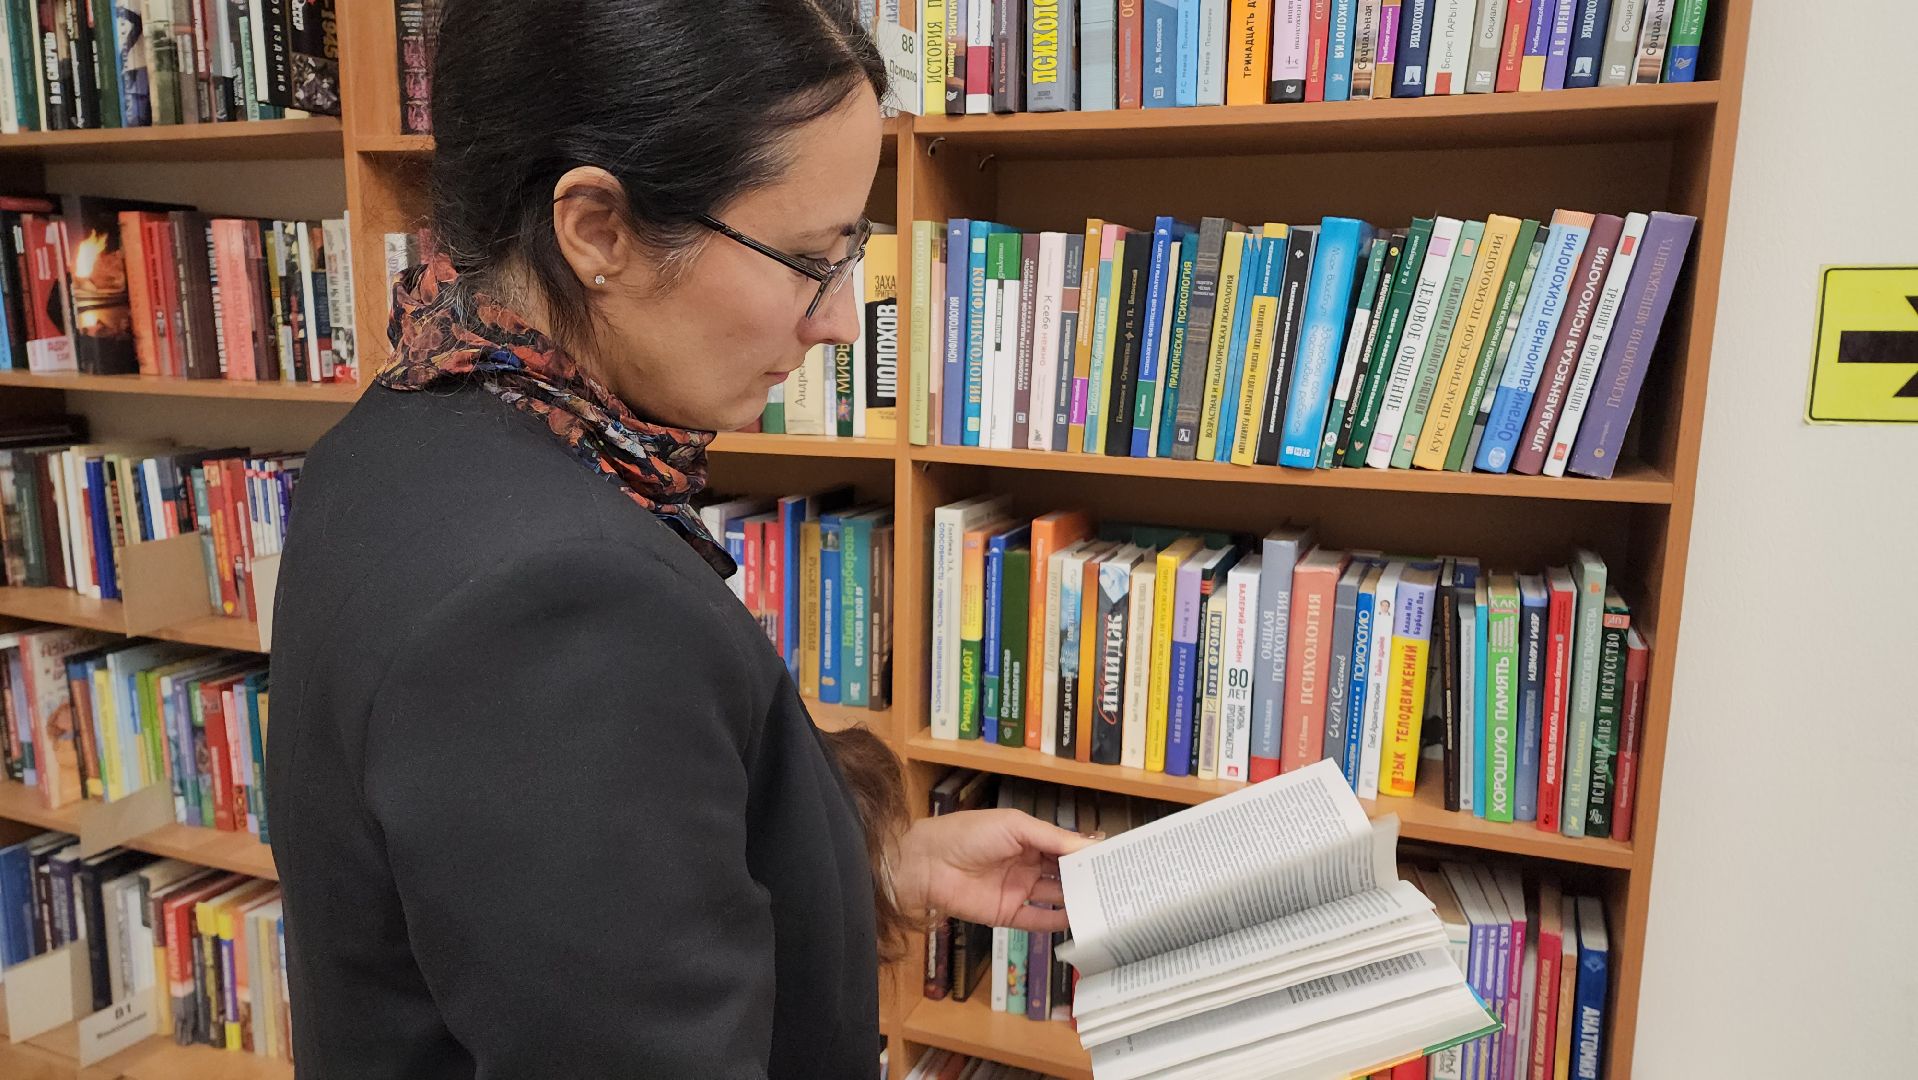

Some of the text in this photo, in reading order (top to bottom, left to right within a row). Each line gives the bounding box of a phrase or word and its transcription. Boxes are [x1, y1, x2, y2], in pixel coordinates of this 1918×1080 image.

[902, 33, 914, 54] 88
[926, 22, 943, 85] ИСТОРИЯ
[1154, 17, 1164, 53] Колесов
[1181, 9, 1191, 50] Психология
[1205, 7, 1214, 48] Психология
[1243, 12, 1256, 79] ТРИНАДЦАТЬ
[1358, 4, 1373, 70] Социальная
[1381, 6, 1394, 63] Учебное пособие
[1440, 41, 1454, 70] Борис
[1531, 26, 1542, 54] Учебное
[946, 41, 957, 78] Лекции
[1127, 268, 1138, 306] Блонский
[1127, 307, 1136, 318] П.
[1151, 269, 1161, 298] КУЛЬТУРЫ
[1287, 281, 1299, 321] Психология
[1503, 281, 1516, 310] ДЕЛОВАЯ
[1595, 288, 1619, 330] ТРЕНИНГ
[947, 296, 960, 364] КОНФЛИКТОЛОГИЯ
[969, 266, 985, 404] КОНФЛИКТОЛОГИЯ
[1041, 304, 1051, 330] себе
[1095, 297, 1108, 333] практика
[1126, 320, 1135, 330] П.
[1147, 298, 1156, 338] ФИЗИЧЕСКОЙ
[1168, 327, 1184, 389] ПРАКТИЧЕСКАЯ
[1176, 261, 1193, 323] ПСИХОЛОГИЯ
[1362, 272, 1392, 363] ВОЗРАСТНАЯ ПСИХОЛОГИЯ
[1387, 277, 1438, 412] ДЕЛОВОЕ ОБЩЕНИЕ
[1429, 235, 1505, 453] КУРС ПРАКТИЧЕСКОЙ ПСИХОЛОГИИ
[1491, 309, 1507, 341] КУЛЬТУРА
[1496, 319, 1549, 443] Организационная
[1541, 233, 1579, 316] психология
[1606, 238, 1674, 408] ПСИХОЛОГИЯ МЕНЕДЖМЕНТА
[876, 303, 898, 399] ШОЛОХОВ
[1091, 340, 1104, 367] теория
[1204, 394, 1218, 439] ВОЗРАСТНАЯ
[1212, 324, 1228, 386] ПЕДАГОГИЧЕСКАЯ
[1221, 274, 1235, 324] ПСИХОЛОГИЯ
[1360, 374, 1382, 428] Практический
[1374, 340, 1393, 375] психолог
[1388, 308, 1400, 334] школе
[1415, 276, 1465, 416] ПСИХОЛОГИЯ ДЕЛОВОГО ОБЩЕНИЯ
[1478, 346, 1495, 386] ПСИХОЛОГИЯ
[1531, 246, 1609, 453] УПРАВЛЕНЧЕСКАЯ ПСИХОЛОГИЯ
[793, 365, 808, 408] Андре
[1311, 381, 1321, 400] сон
[1468, 386, 1482, 416] ОБЩЕНИЯ
[1568, 343, 1601, 412] ОРГАНИЗАЦИИ
[842, 527, 855, 647] Нина Берберова
[936, 588, 945, 628] ЛИЧНОСТЬ
[1402, 598, 1414, 635] Аллан Пиз
[1413, 592, 1425, 636] Барбара Пиз
[854, 597, 864, 657] КУРСИВ МОЙ
[1235, 583, 1247, 663] ВАЛЕРИЙ ЛЕЙБИН
[1260, 610, 1274, 660] ОБЩАЯ
[1271, 590, 1289, 683] ПСИХОЛОГИЯ
[1299, 592, 1322, 705] ПСИХОЛОГИЯ
[1000, 648, 1011, 718] Юридическая
[1102, 613, 1124, 713] ИМИДЖ
[1208, 615, 1221, 694] ЭРИХ ФРОММ
[1228, 667, 1249, 688] 80
[1494, 645, 1510, 721] ПАМЯТЬ
[1527, 640, 1539, 682] КАРНЕГИ
[1578, 606, 1599, 713] ПСИХОЛОГИЯ ТВОРЧЕСТВА
[960, 648, 974, 732] Ричард ДАФТ
[1012, 661, 1021, 719] психология
[1173, 646, 1187, 744] ДЕЛОВОЕ ОБЩЕНИЕ
[1227, 688, 1247, 701] ЛЕТ
[1236, 704, 1246, 730] ЖИЗНЬ
[1366, 682, 1381, 749] Глеб Архангельский
[1394, 645, 1418, 743] ТЕЛОДВИЖЕНИЙ
[1591, 633, 1620, 804] ПСИХОАНАЛИЗ И ИСКУССТВО
[1492, 726, 1509, 815] ХОРОШУЮ
[1578, 1005, 1601, 1079] АНАТОМИЯ
